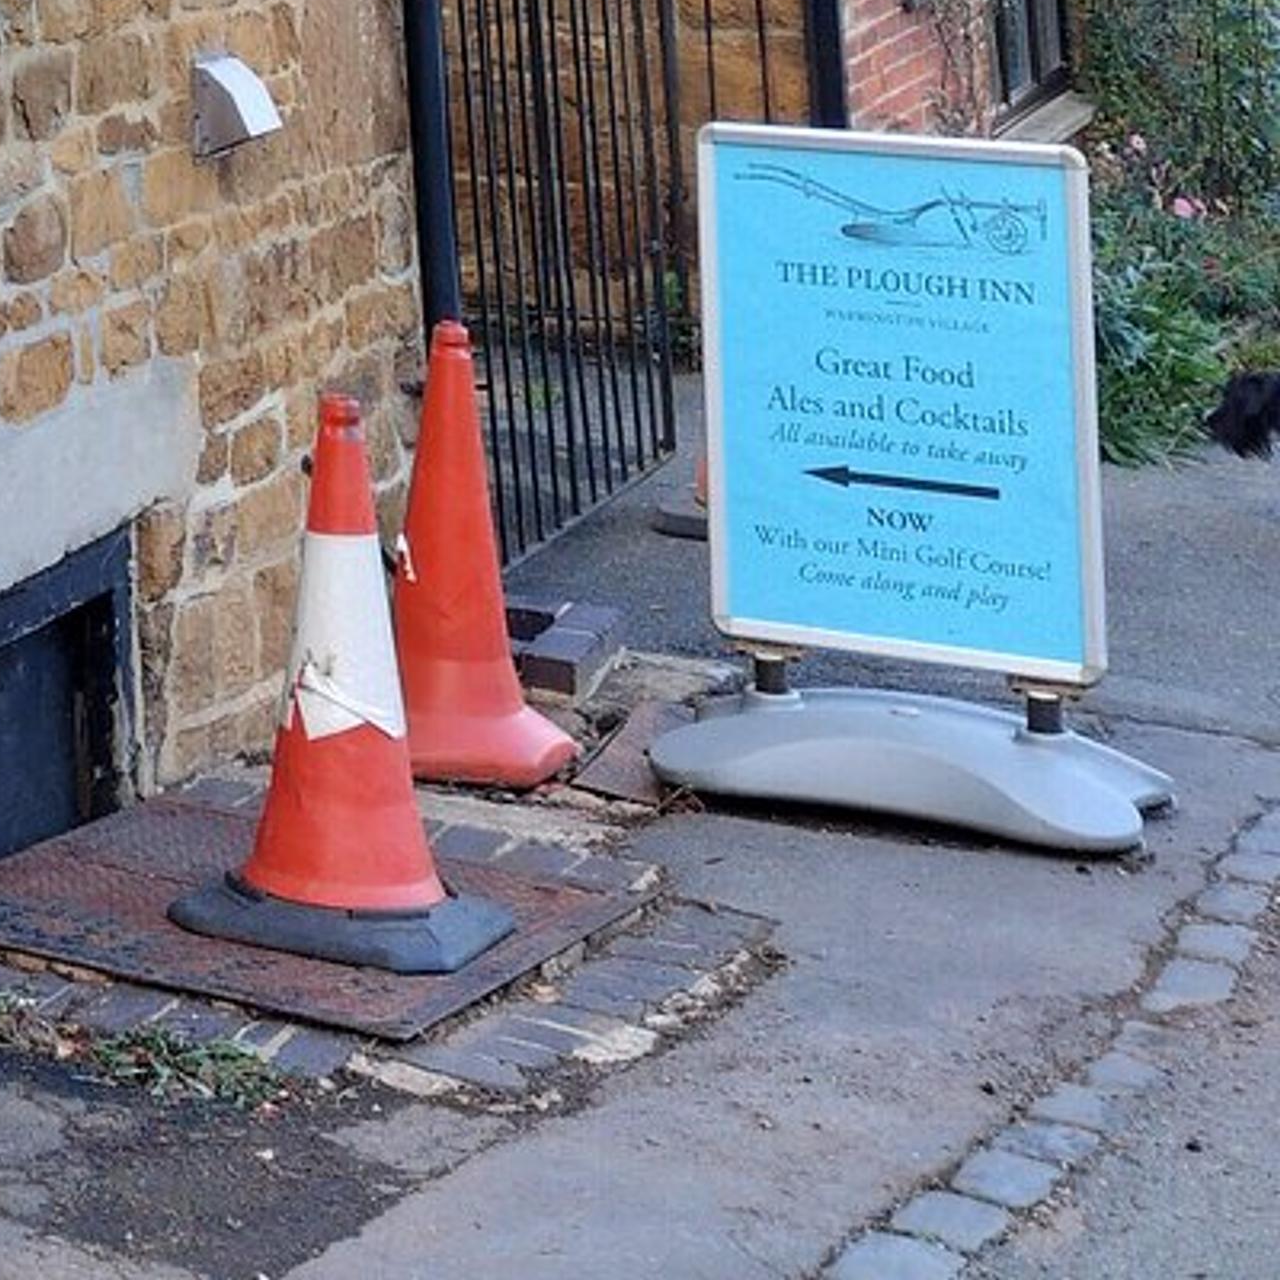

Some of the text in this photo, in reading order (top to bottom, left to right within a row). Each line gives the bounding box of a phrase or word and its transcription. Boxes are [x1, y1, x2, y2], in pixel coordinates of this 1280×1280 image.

[775, 261, 1035, 305] THE PLOUGH INN
[815, 346, 975, 389] Great Food
[768, 386, 1029, 437] Ales and Cocktails
[770, 423, 1029, 475] All available to take away
[867, 507, 936, 533] NOW
[754, 524, 1052, 582] With our Mini Golf Course!
[798, 562, 1010, 613] Come along and play
